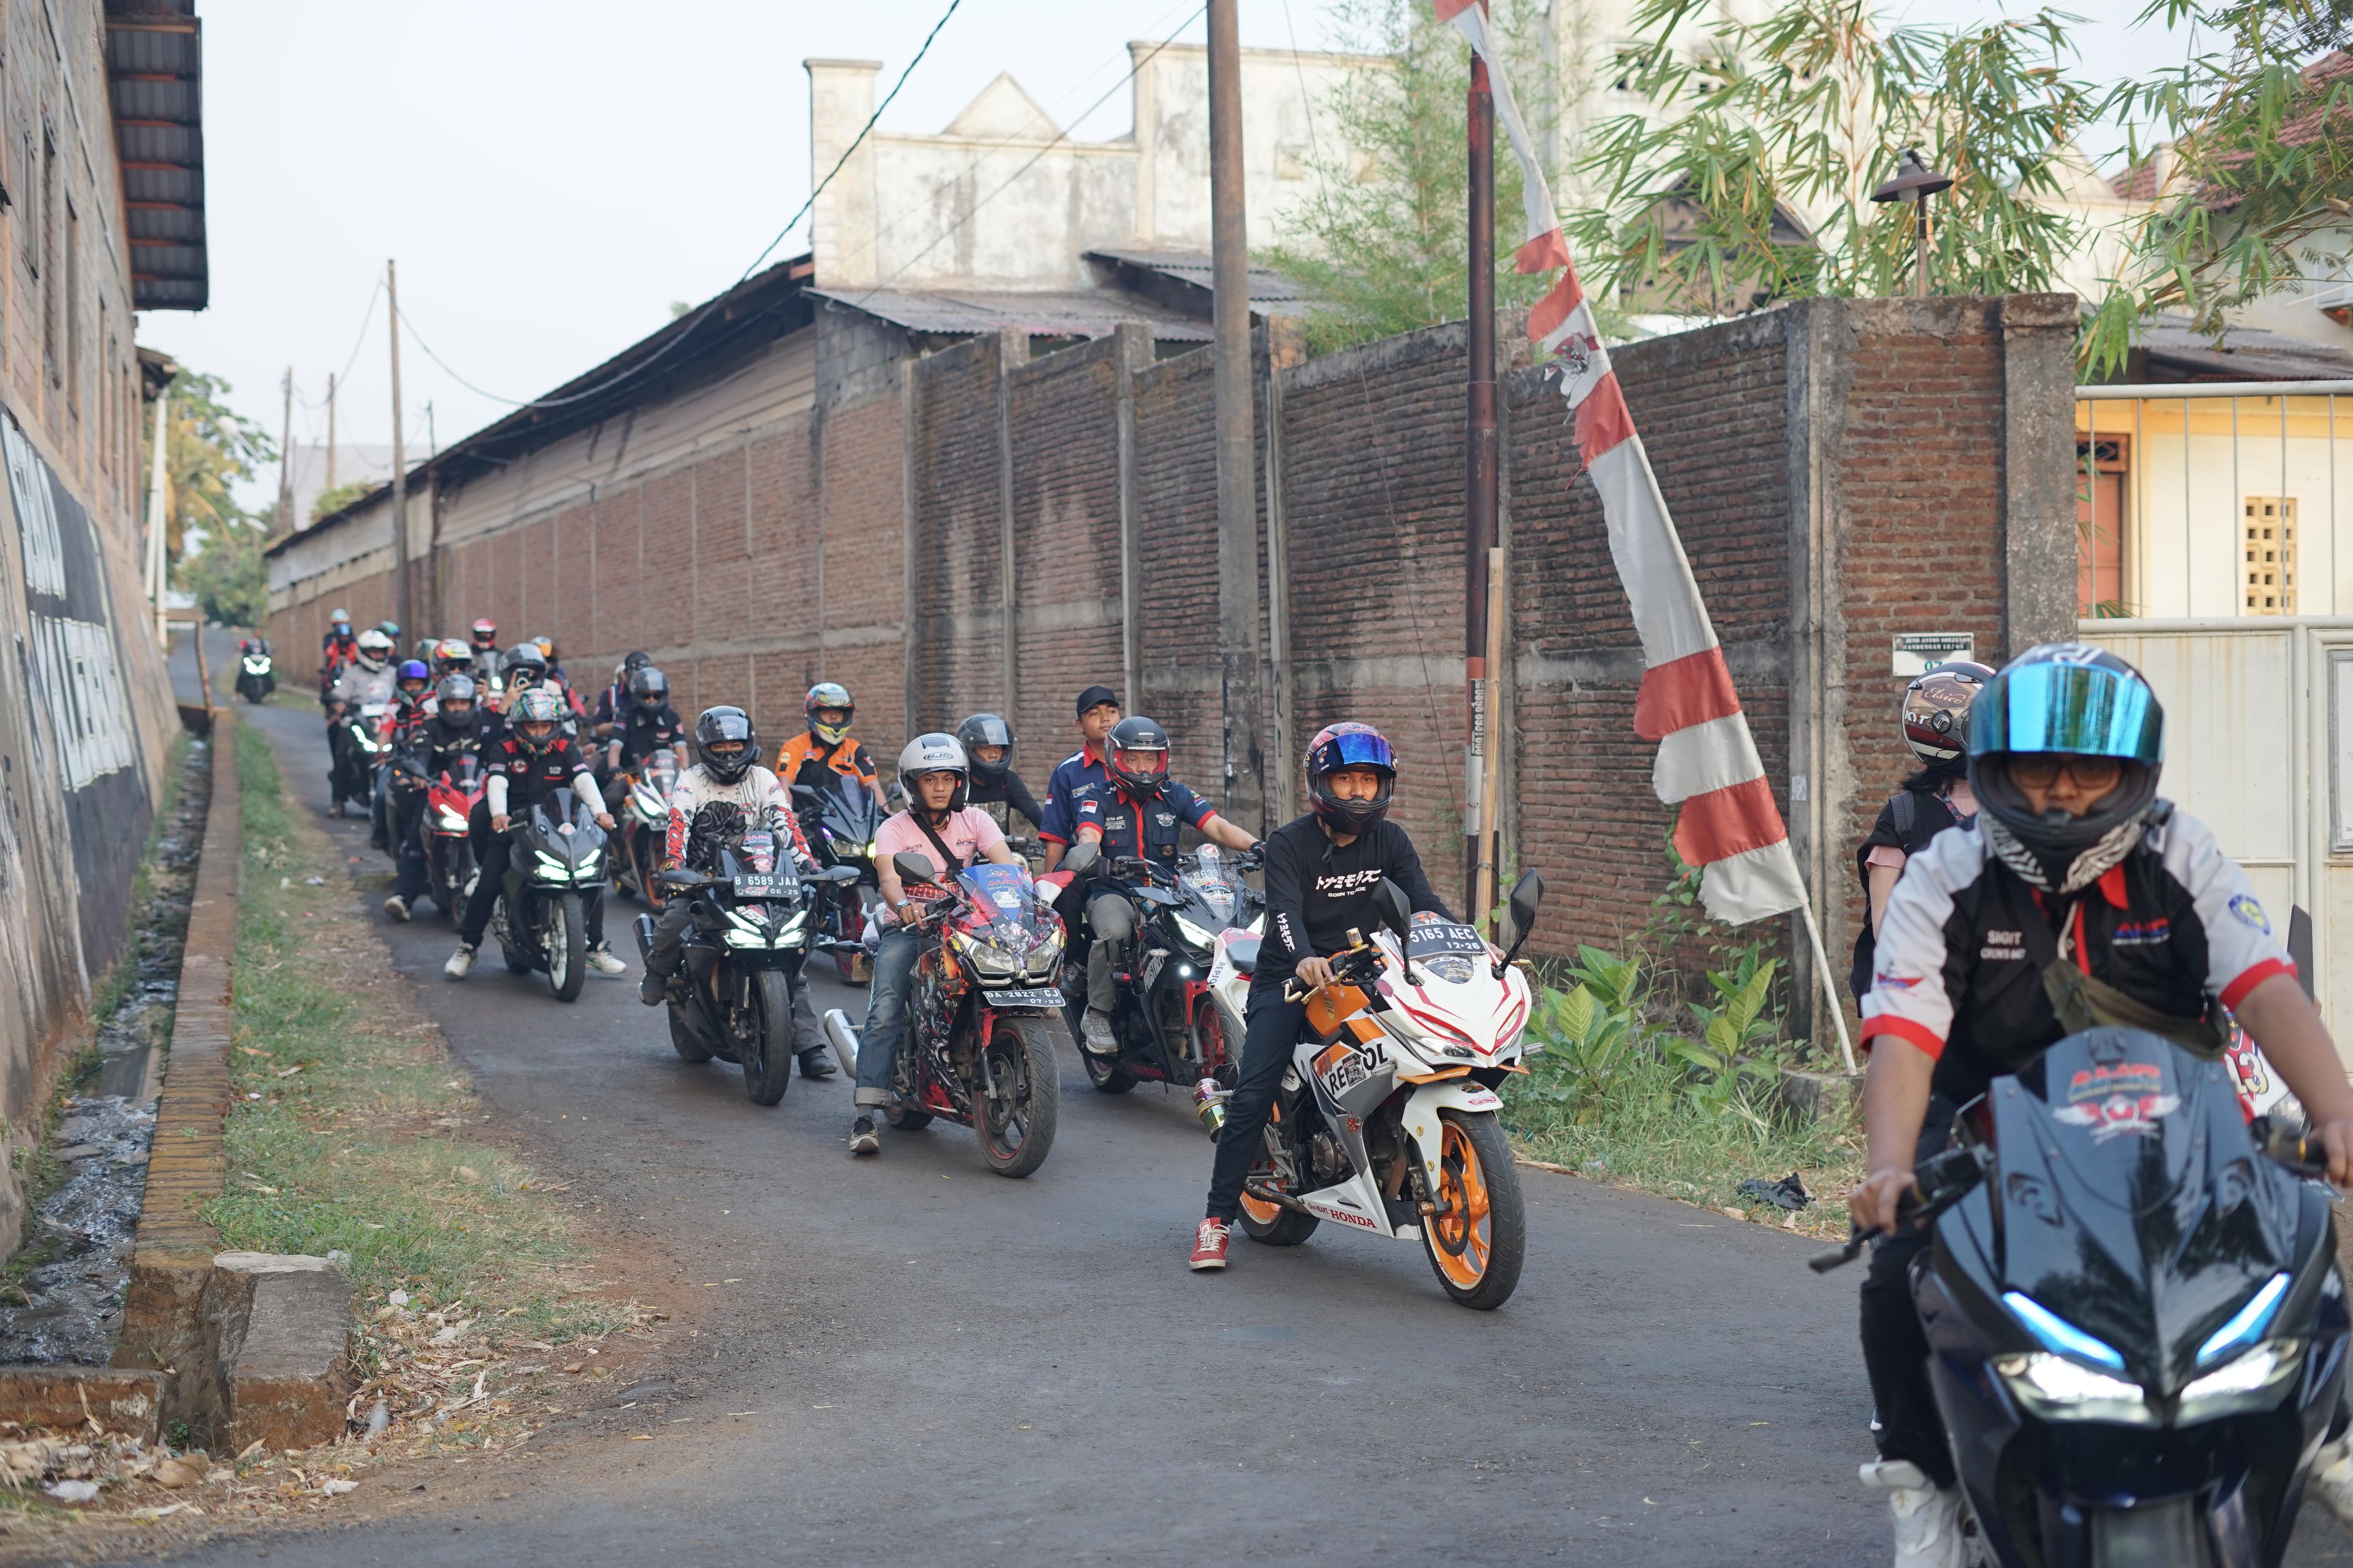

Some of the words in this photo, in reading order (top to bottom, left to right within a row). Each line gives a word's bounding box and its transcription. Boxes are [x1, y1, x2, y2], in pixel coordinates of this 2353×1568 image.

[1904, 710, 1930, 724] KYT
[735, 876, 742, 885] B
[748, 876, 774, 885] 6589
[778, 876, 798, 886] JAA
[1411, 927, 1445, 943] 5165
[1449, 927, 1475, 940] AEC
[1208, 962, 1227, 985] REPSO
[1132, 1061, 1165, 1078] HONDA
[1329, 1043, 1388, 1096] REOL
[2224, 1052, 2269, 1095] 13
[1315, 1205, 1329, 1215] HEART
[1329, 1209, 1378, 1229] HONDA
